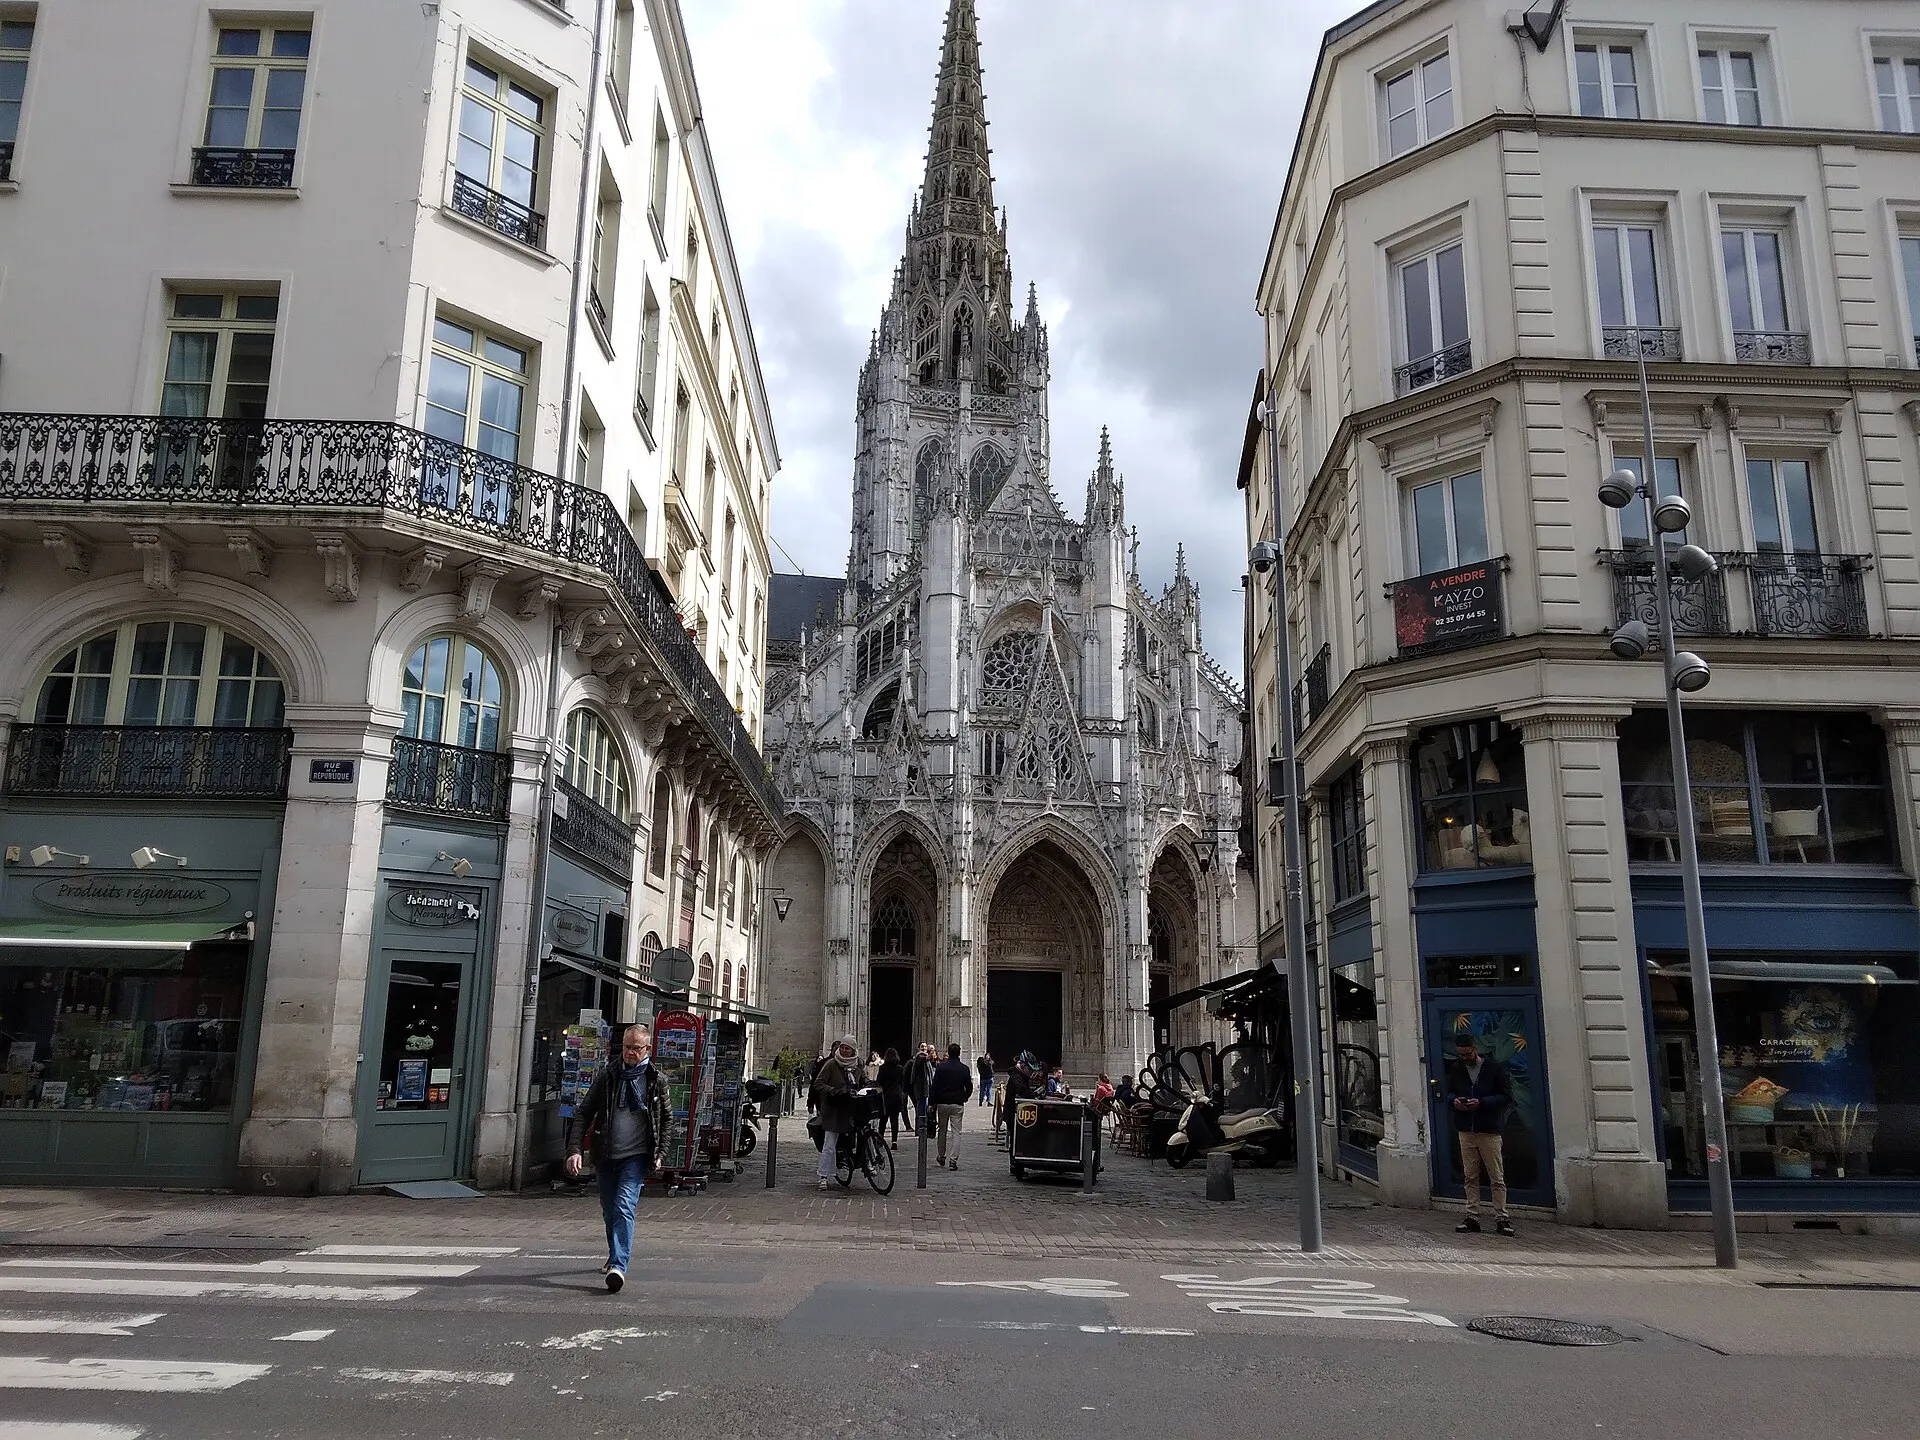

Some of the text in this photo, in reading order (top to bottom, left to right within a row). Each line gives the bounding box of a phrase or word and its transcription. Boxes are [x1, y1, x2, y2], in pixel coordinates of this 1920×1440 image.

[1430, 569, 1486, 590] A VENDRE
[1446, 600, 1473, 613] INVEST
[1435, 618, 1445, 626] 02
[1445, 616, 1455, 624] 35
[1476, 609, 1486, 617] 55
[312, 771, 350, 780] RÉPUBLIQUE
[57, 878, 207, 907] Produits régionaux
[413, 907, 458, 920] Normand
